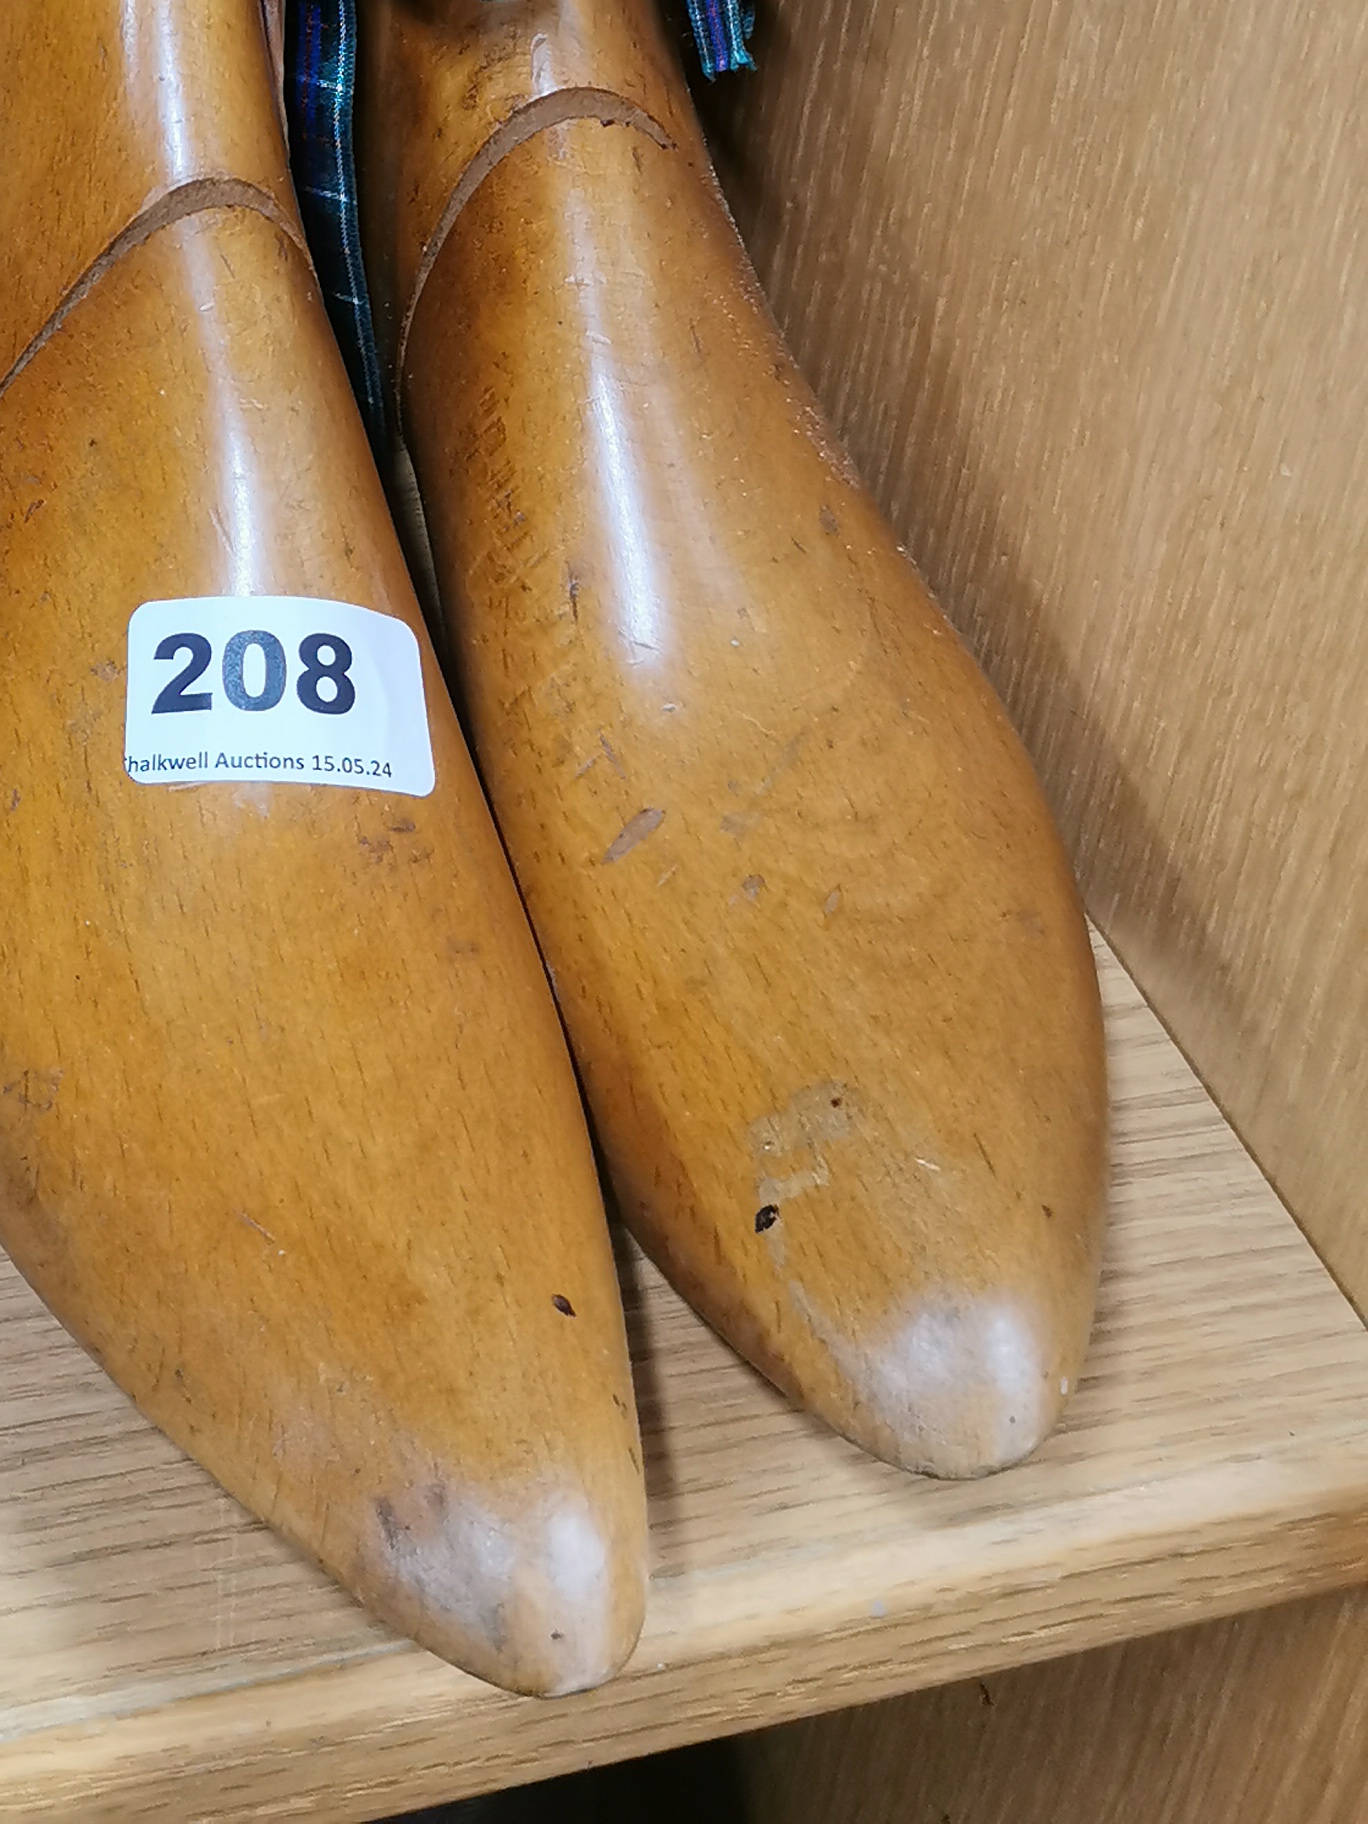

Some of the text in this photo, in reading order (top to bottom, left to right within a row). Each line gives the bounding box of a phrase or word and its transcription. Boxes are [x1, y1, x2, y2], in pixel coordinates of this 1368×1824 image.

[150, 629, 356, 715] 208
[124, 751, 393, 778] halkwell Auctions 15.05.24
